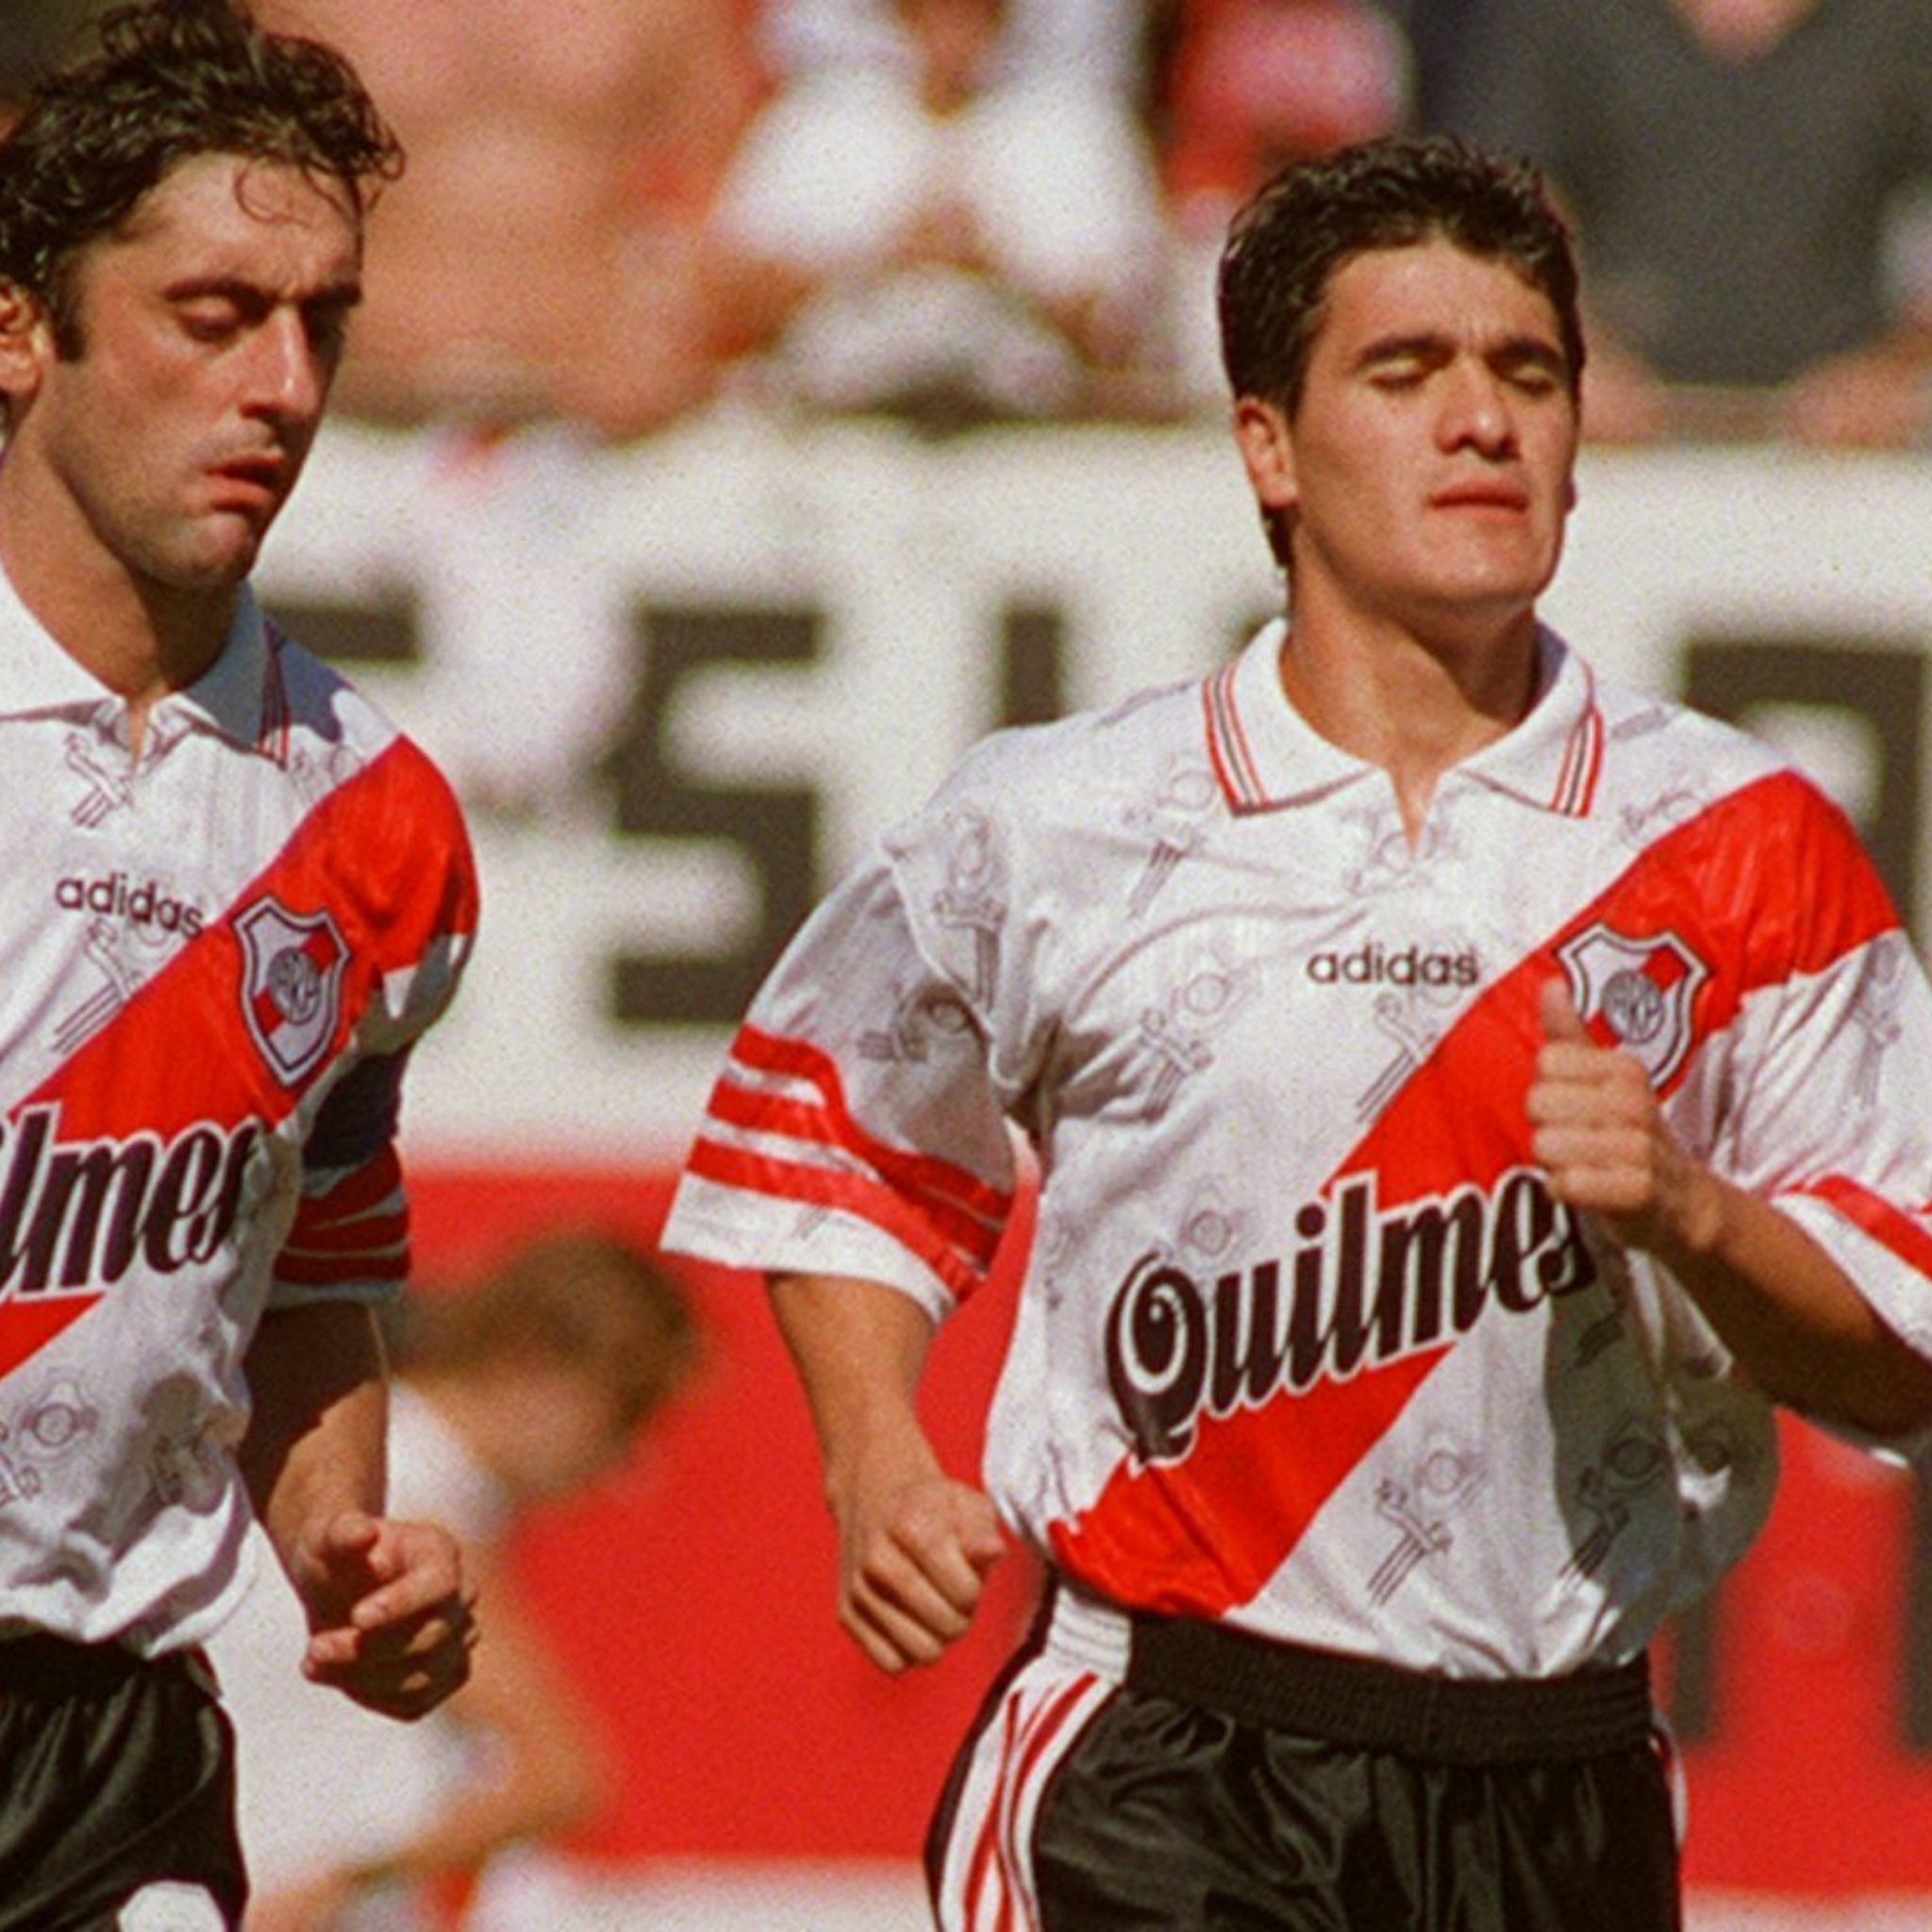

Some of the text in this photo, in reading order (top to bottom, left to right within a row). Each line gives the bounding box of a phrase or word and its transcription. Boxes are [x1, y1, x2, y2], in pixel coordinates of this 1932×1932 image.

[56, 872, 203, 940] adidas
[1307, 941, 1478, 988] adidas
[0, 1110, 260, 1292] lmes
